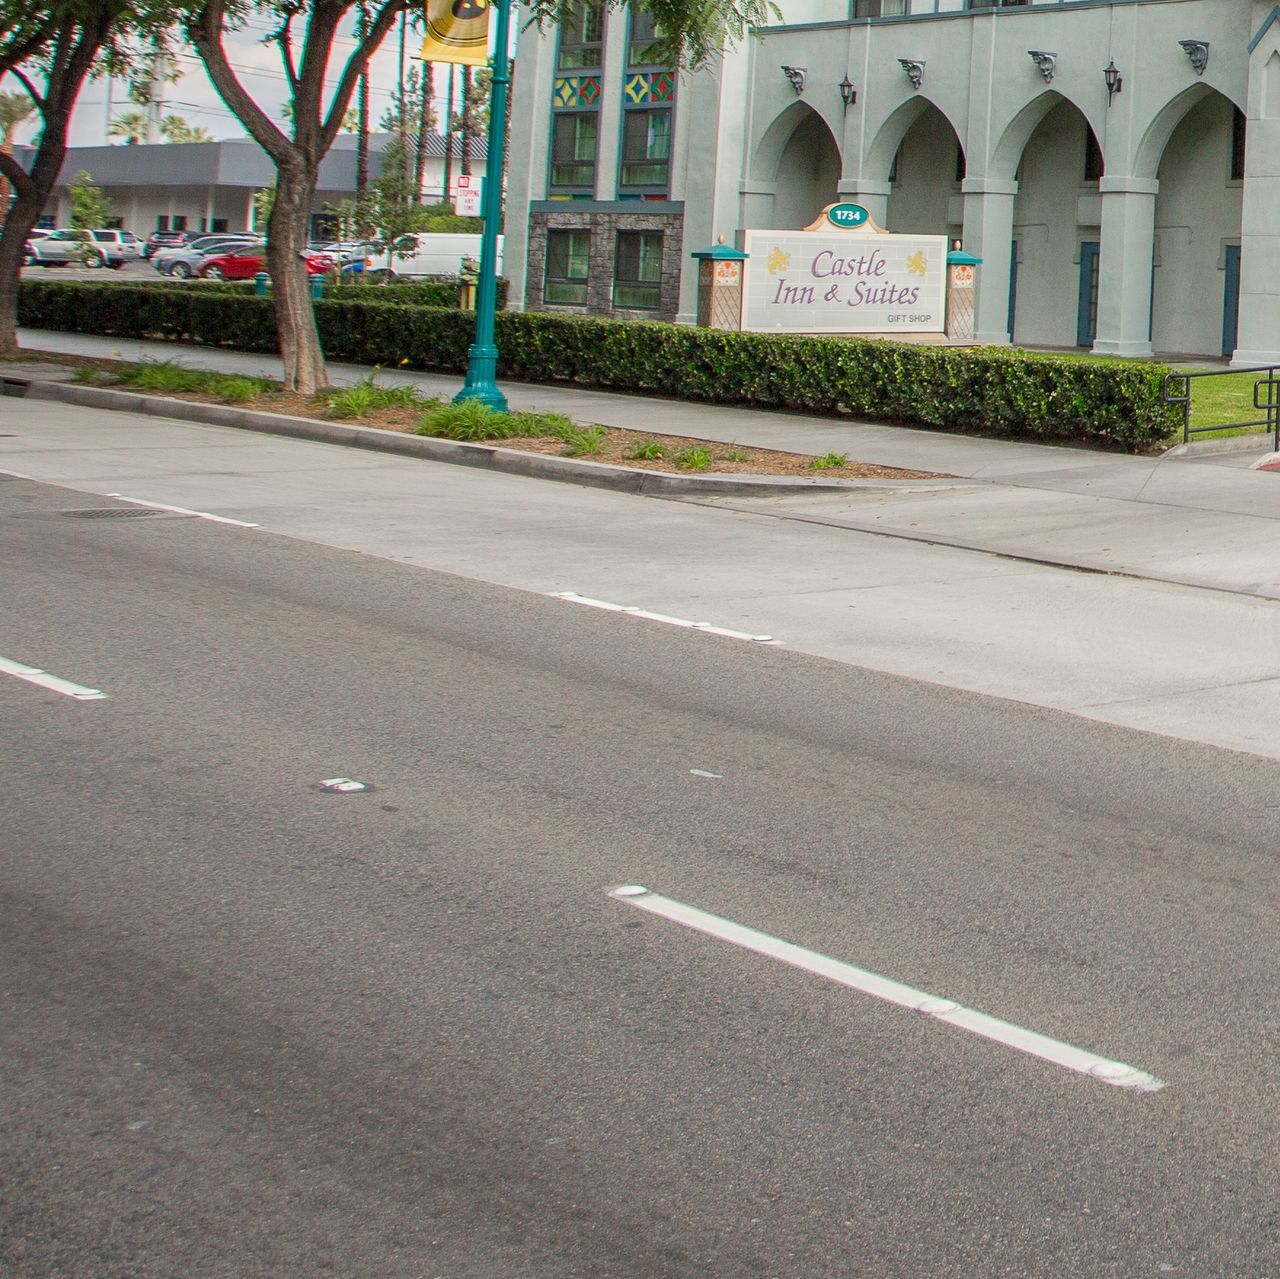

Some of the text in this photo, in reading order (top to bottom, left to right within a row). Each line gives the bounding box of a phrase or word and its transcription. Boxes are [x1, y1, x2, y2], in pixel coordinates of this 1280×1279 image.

[835, 210, 860, 221] 1734
[812, 249, 886, 278] Castle
[772, 278, 920, 307] Inn & Suites
[888, 314, 931, 323] GIFT SHOP
